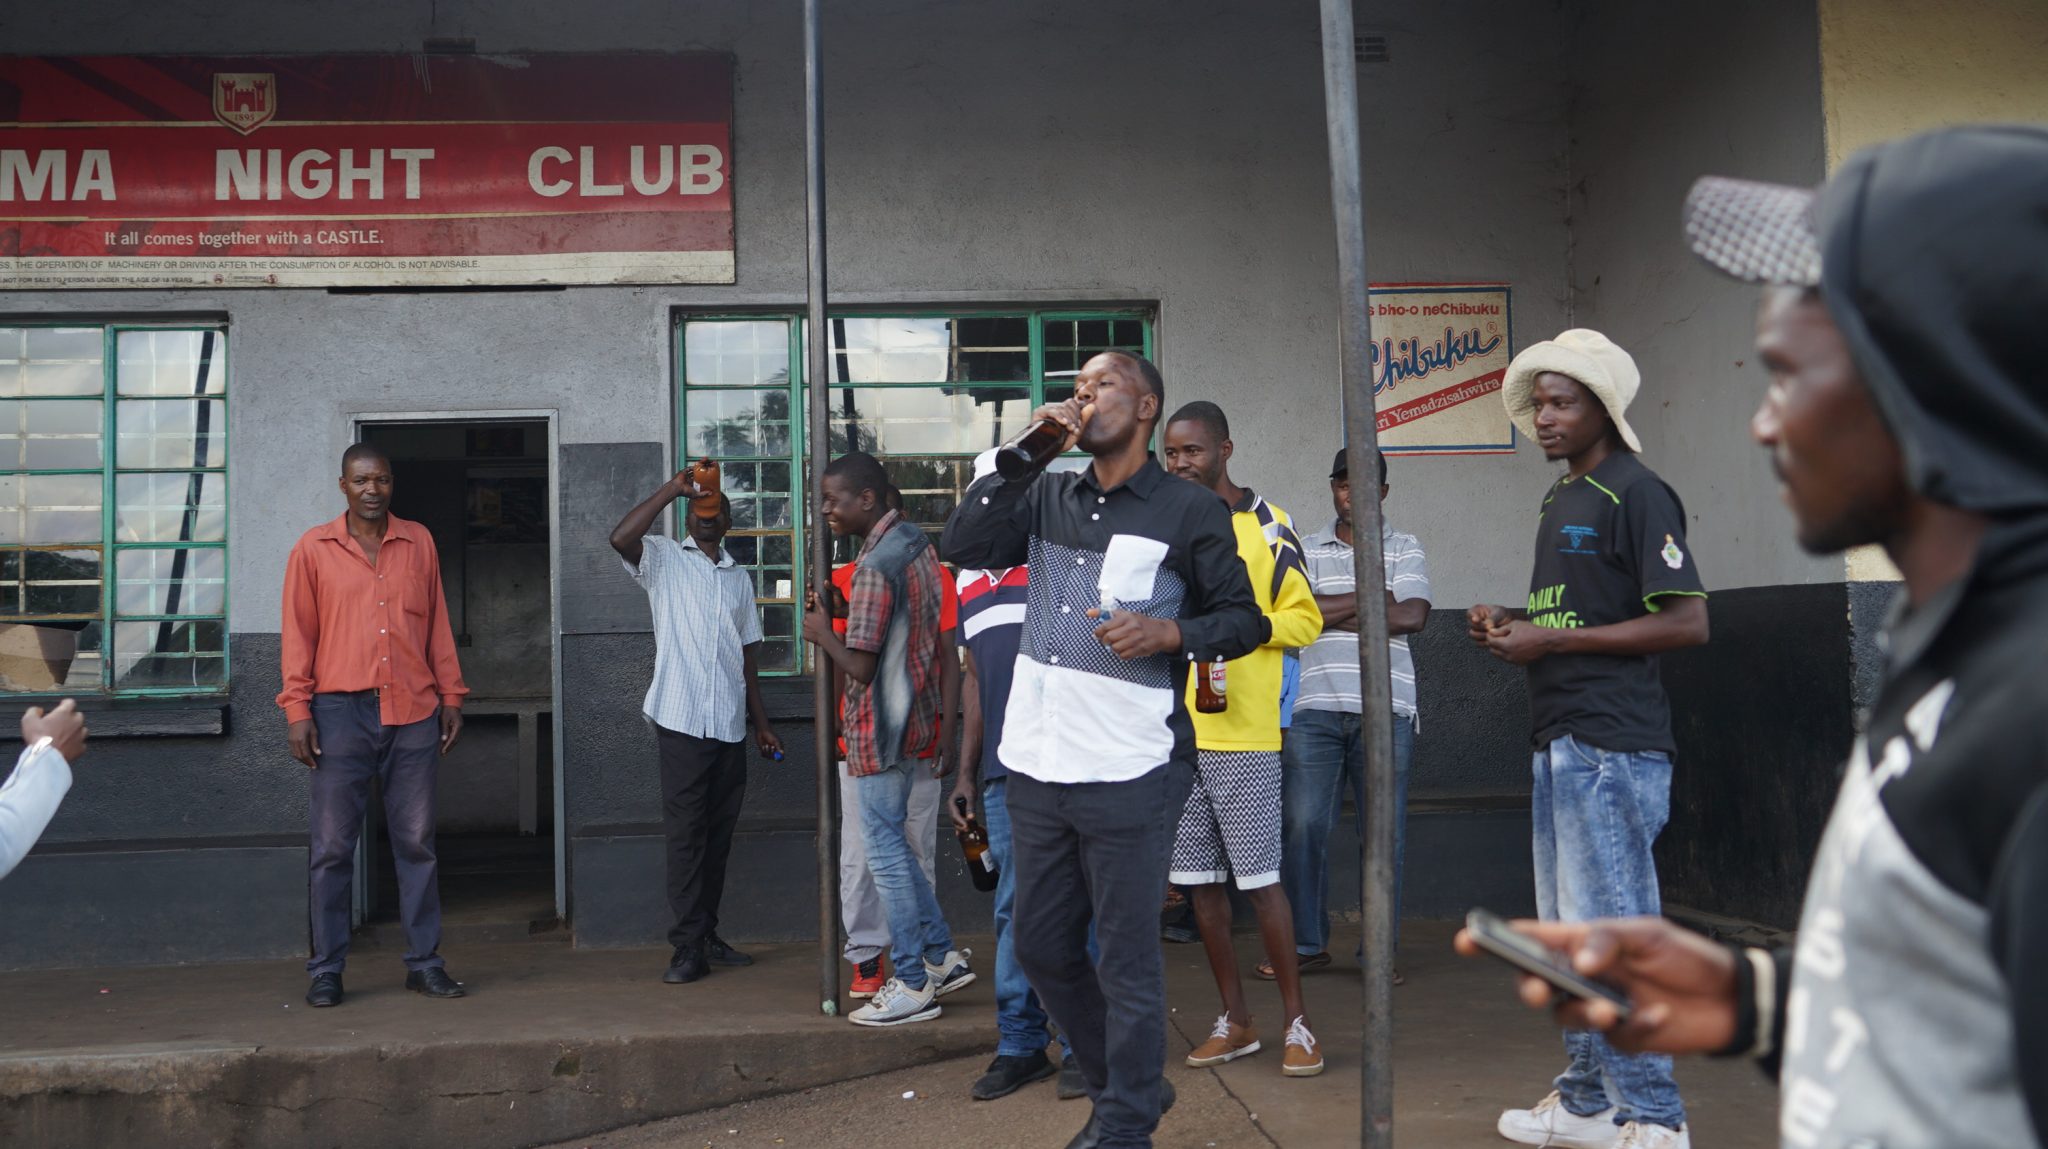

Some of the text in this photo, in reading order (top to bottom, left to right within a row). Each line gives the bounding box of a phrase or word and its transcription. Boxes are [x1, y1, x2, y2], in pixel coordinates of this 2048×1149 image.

[0, 144, 724, 201] MA NIGHT CLUB
[104, 230, 384, 248] It all comes together with a CASTLE.
[16, 261, 33, 269] THE
[35, 260, 88, 269] OPERATION
[90, 260, 103, 269] OF
[108, 260, 161, 269] MACHINERY
[163, 260, 178, 269] OR
[180, 260, 216, 269] DRIVING
[218, 261, 248, 269] AFTER
[250, 261, 267, 269] THE
[269, 261, 336, 269] CONSUMPTION
[338, 261, 351, 269] OF
[352, 261, 396, 269] ALCOHOL
[398, 261, 407, 269] IS
[408, 261, 427, 269] NOT
[429, 260, 480, 268] ADVISABLE.
[1378, 304, 1419, 316] bho-o
[1423, 303, 1500, 316] neChibuku
[1389, 378, 1501, 424] Yemadzisahwira
